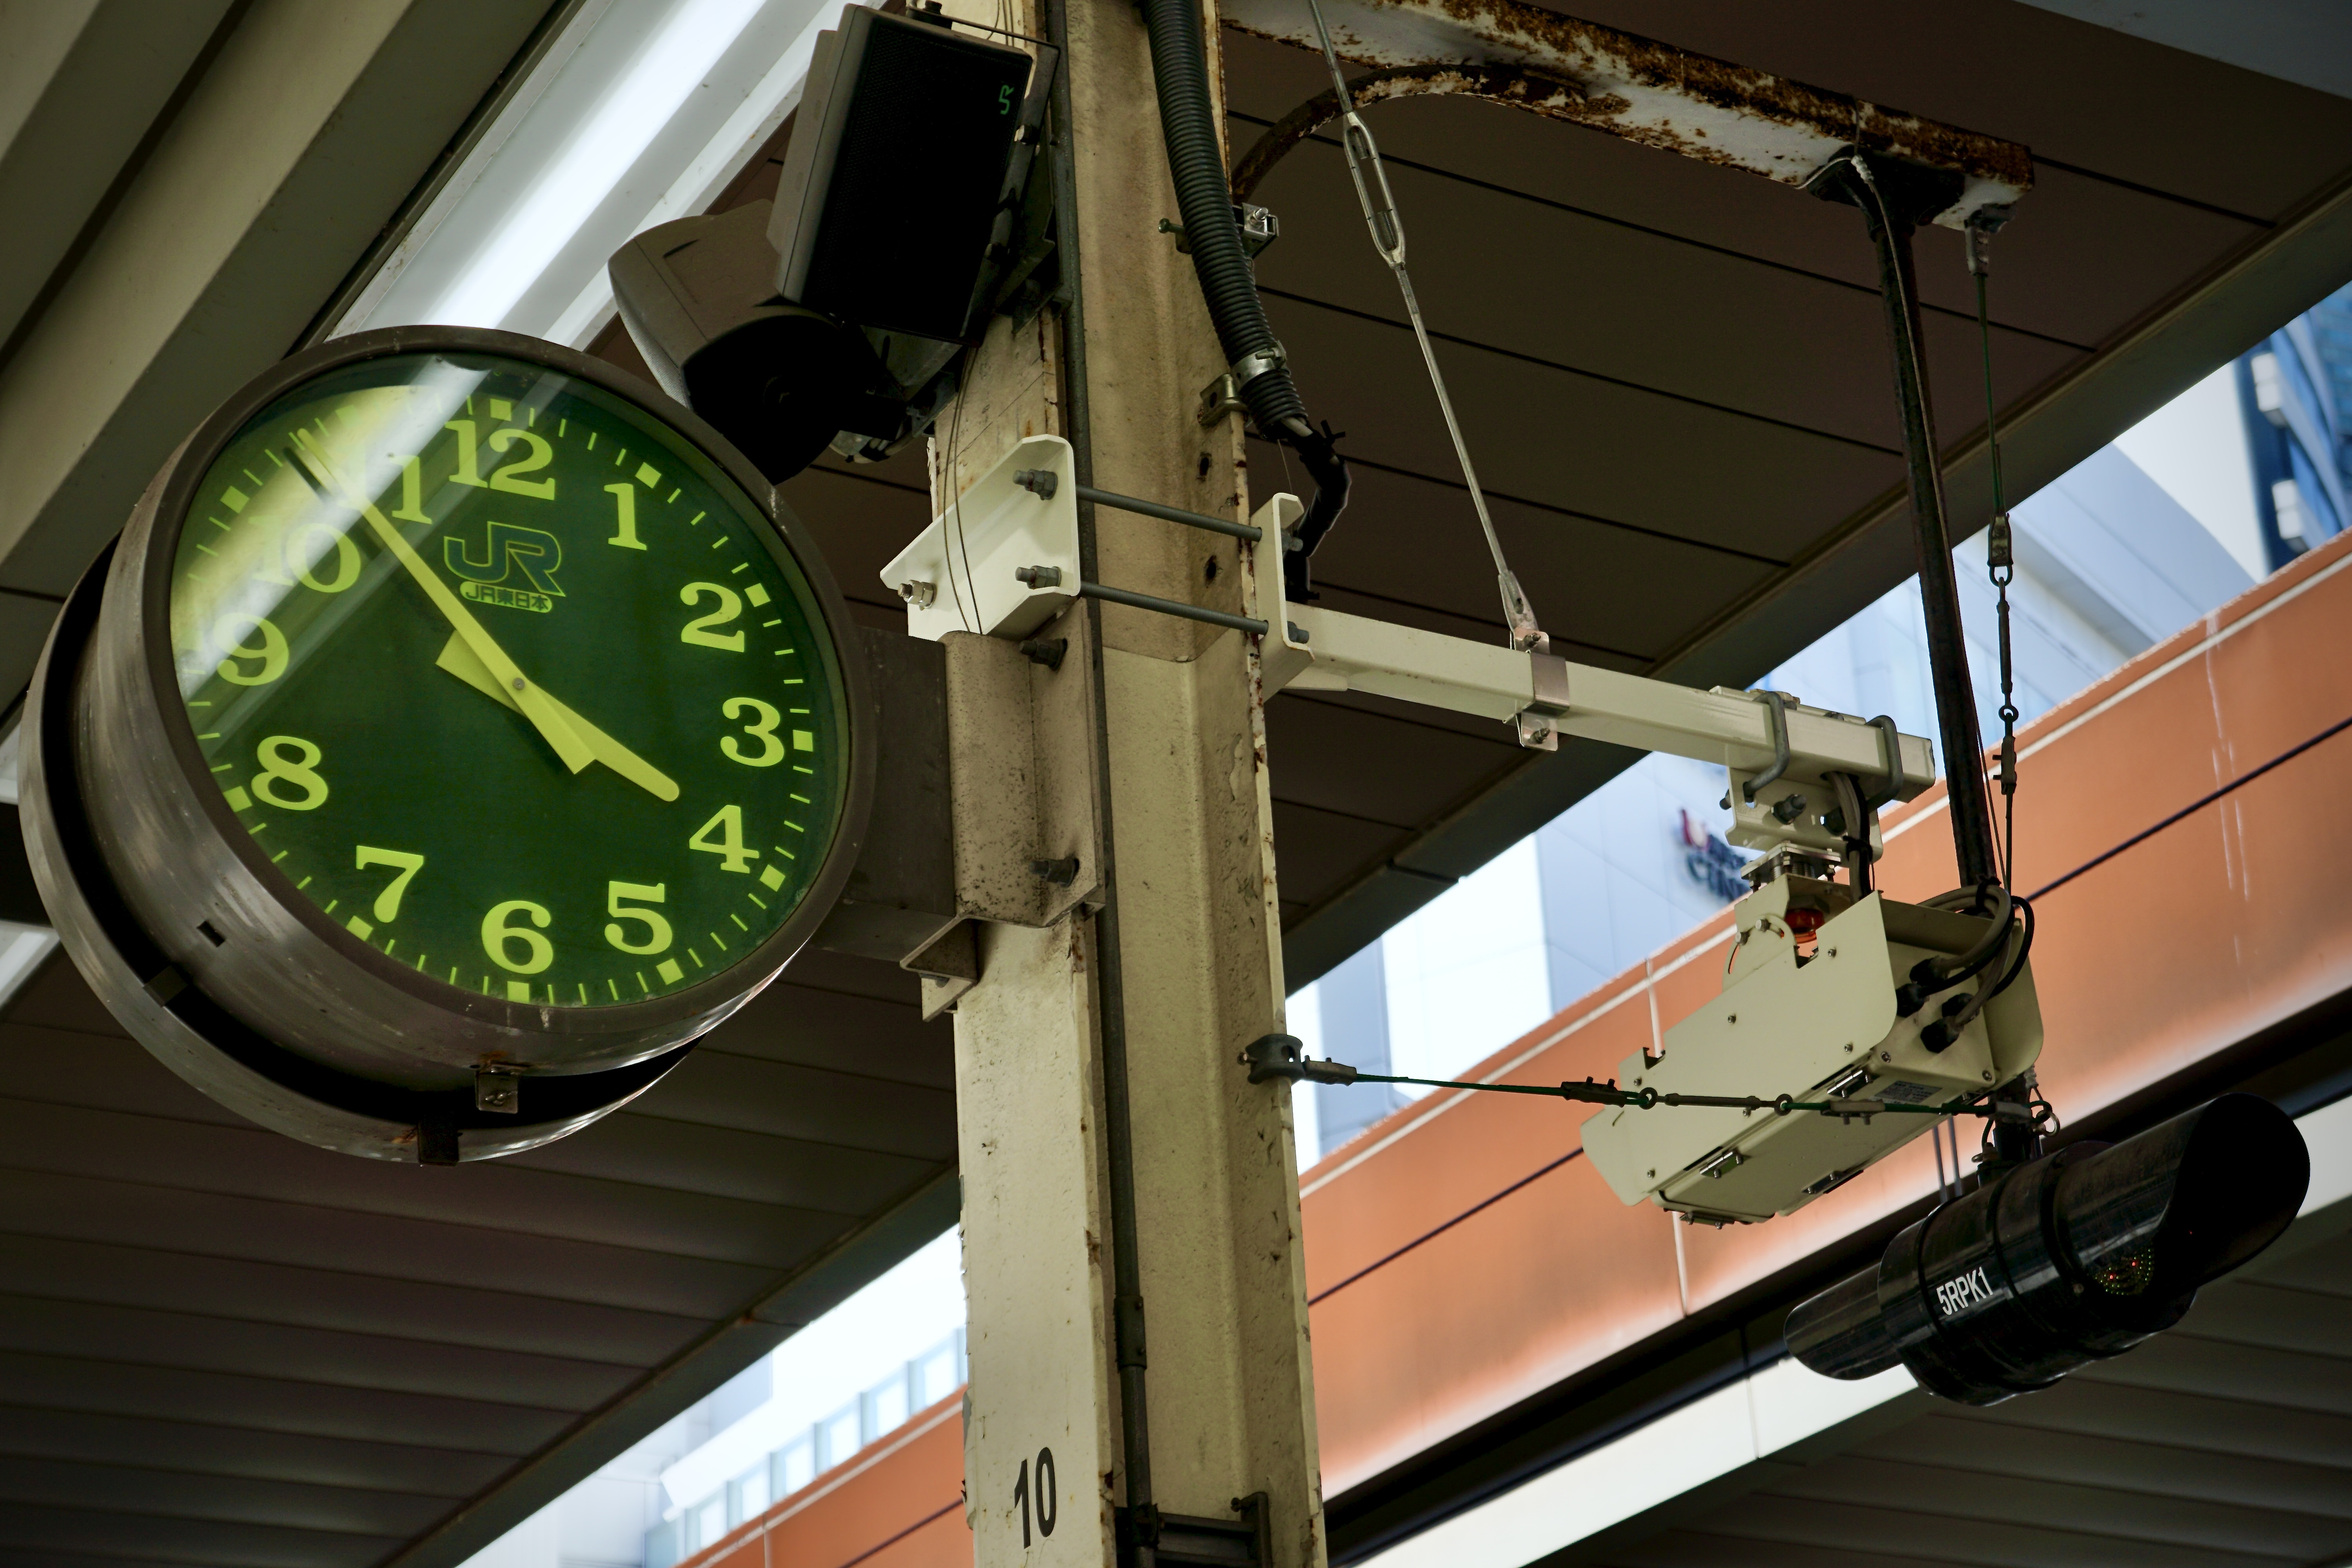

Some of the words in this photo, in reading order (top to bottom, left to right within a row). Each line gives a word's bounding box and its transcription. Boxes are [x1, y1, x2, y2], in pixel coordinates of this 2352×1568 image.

[444, 419, 556, 501] 12
[604, 483, 648, 551] 1
[443, 521, 566, 597] JR
[465, 584, 550, 612] JR東日本
[680, 582, 745, 653] 2
[211, 612, 290, 686] 9
[720, 697, 785, 767] 3
[251, 735, 329, 811] 8
[689, 804, 760, 874] 4
[356, 845, 425, 923] 7
[604, 880, 673, 955] 5
[481, 900, 554, 975] 6
[1936, 1267, 1993, 1316] 5RPK1
[1014, 1446, 1056, 1550] 10
